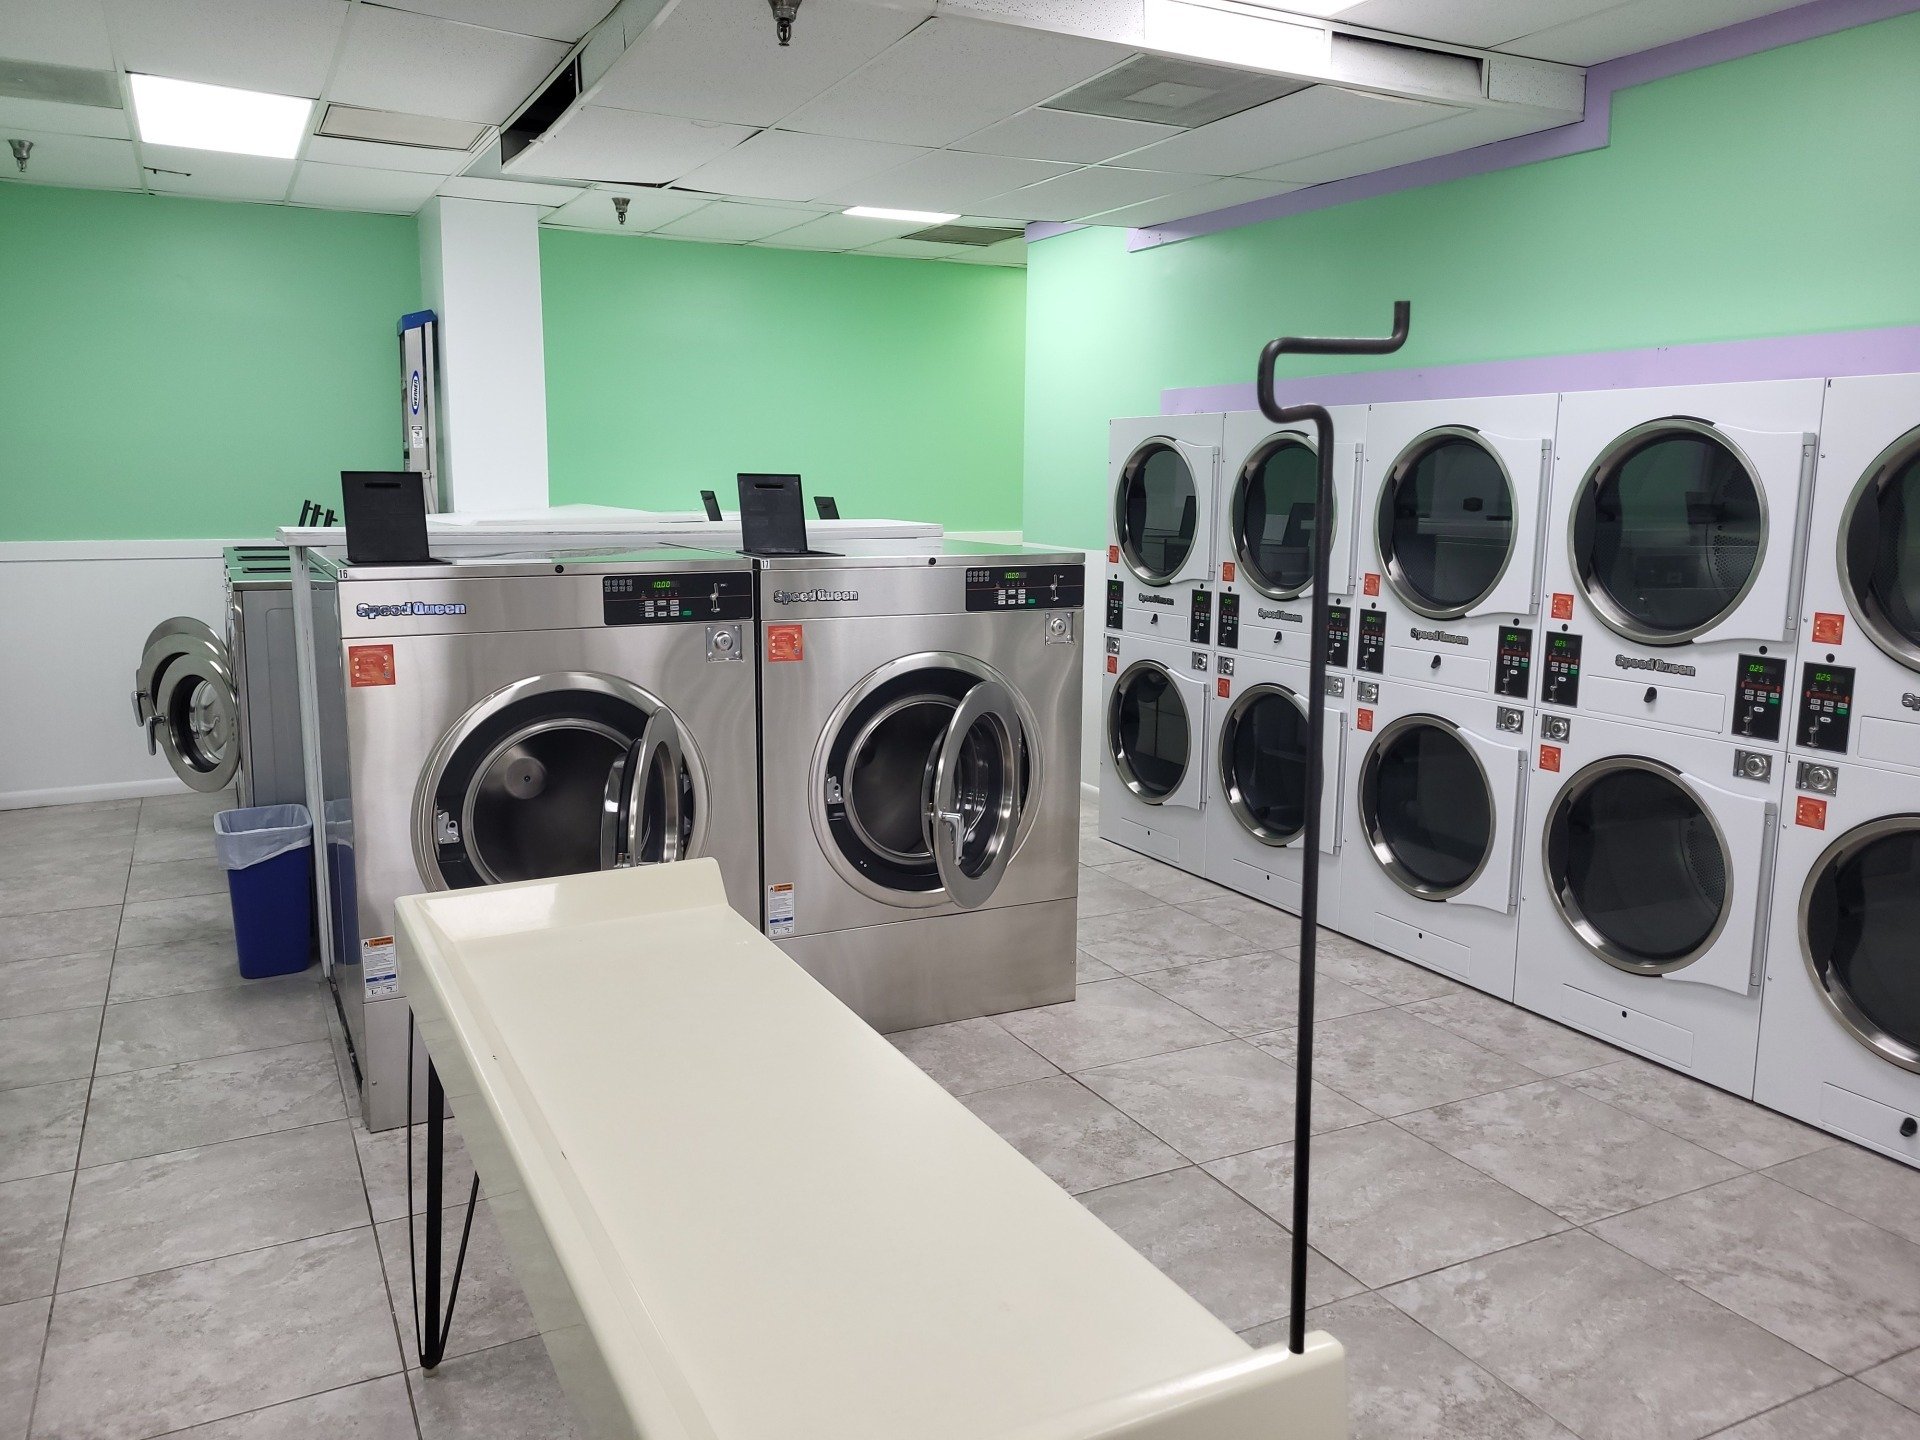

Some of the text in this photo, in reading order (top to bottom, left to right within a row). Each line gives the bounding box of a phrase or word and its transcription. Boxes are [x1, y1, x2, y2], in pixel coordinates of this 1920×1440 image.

[761, 560, 769, 569] 17
[339, 570, 348, 579] 16
[774, 589, 817, 605] Speed
[356, 601, 466, 619] Speed Queen
[1410, 627, 1439, 641] Speed
[1615, 653, 1696, 677] Speed Queen
